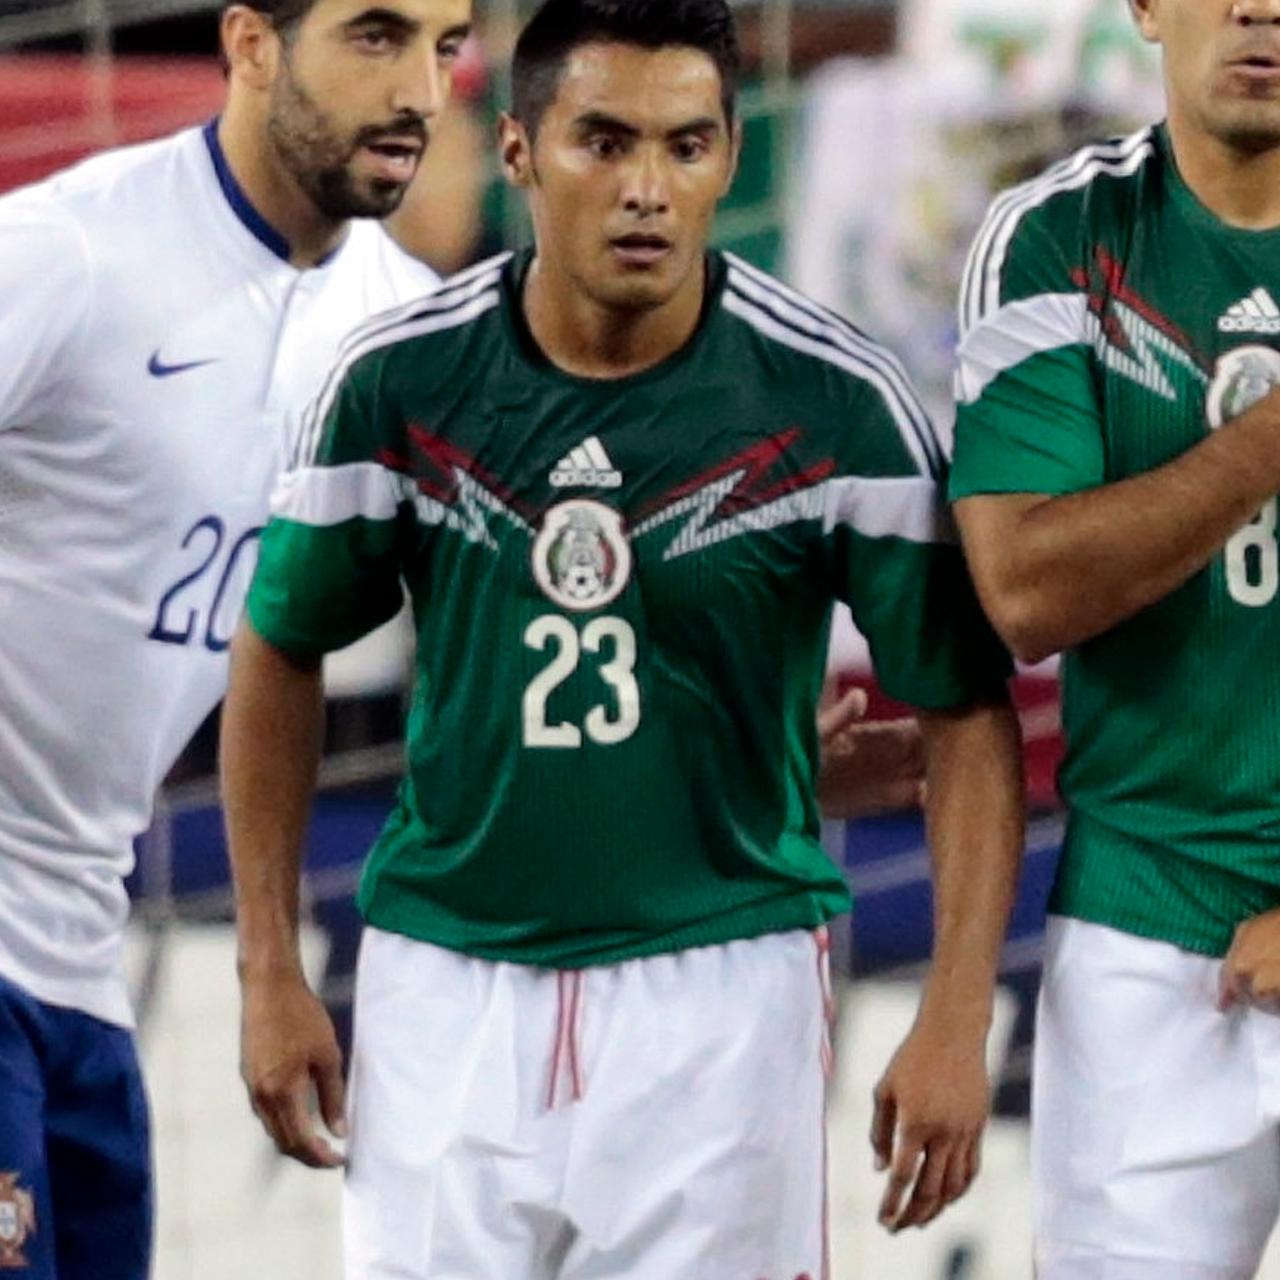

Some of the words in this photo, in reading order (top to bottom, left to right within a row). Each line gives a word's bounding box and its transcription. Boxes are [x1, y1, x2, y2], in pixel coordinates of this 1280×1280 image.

[147, 514, 268, 652] 20
[1224, 495, 1279, 607] 8
[522, 614, 641, 748] 23
